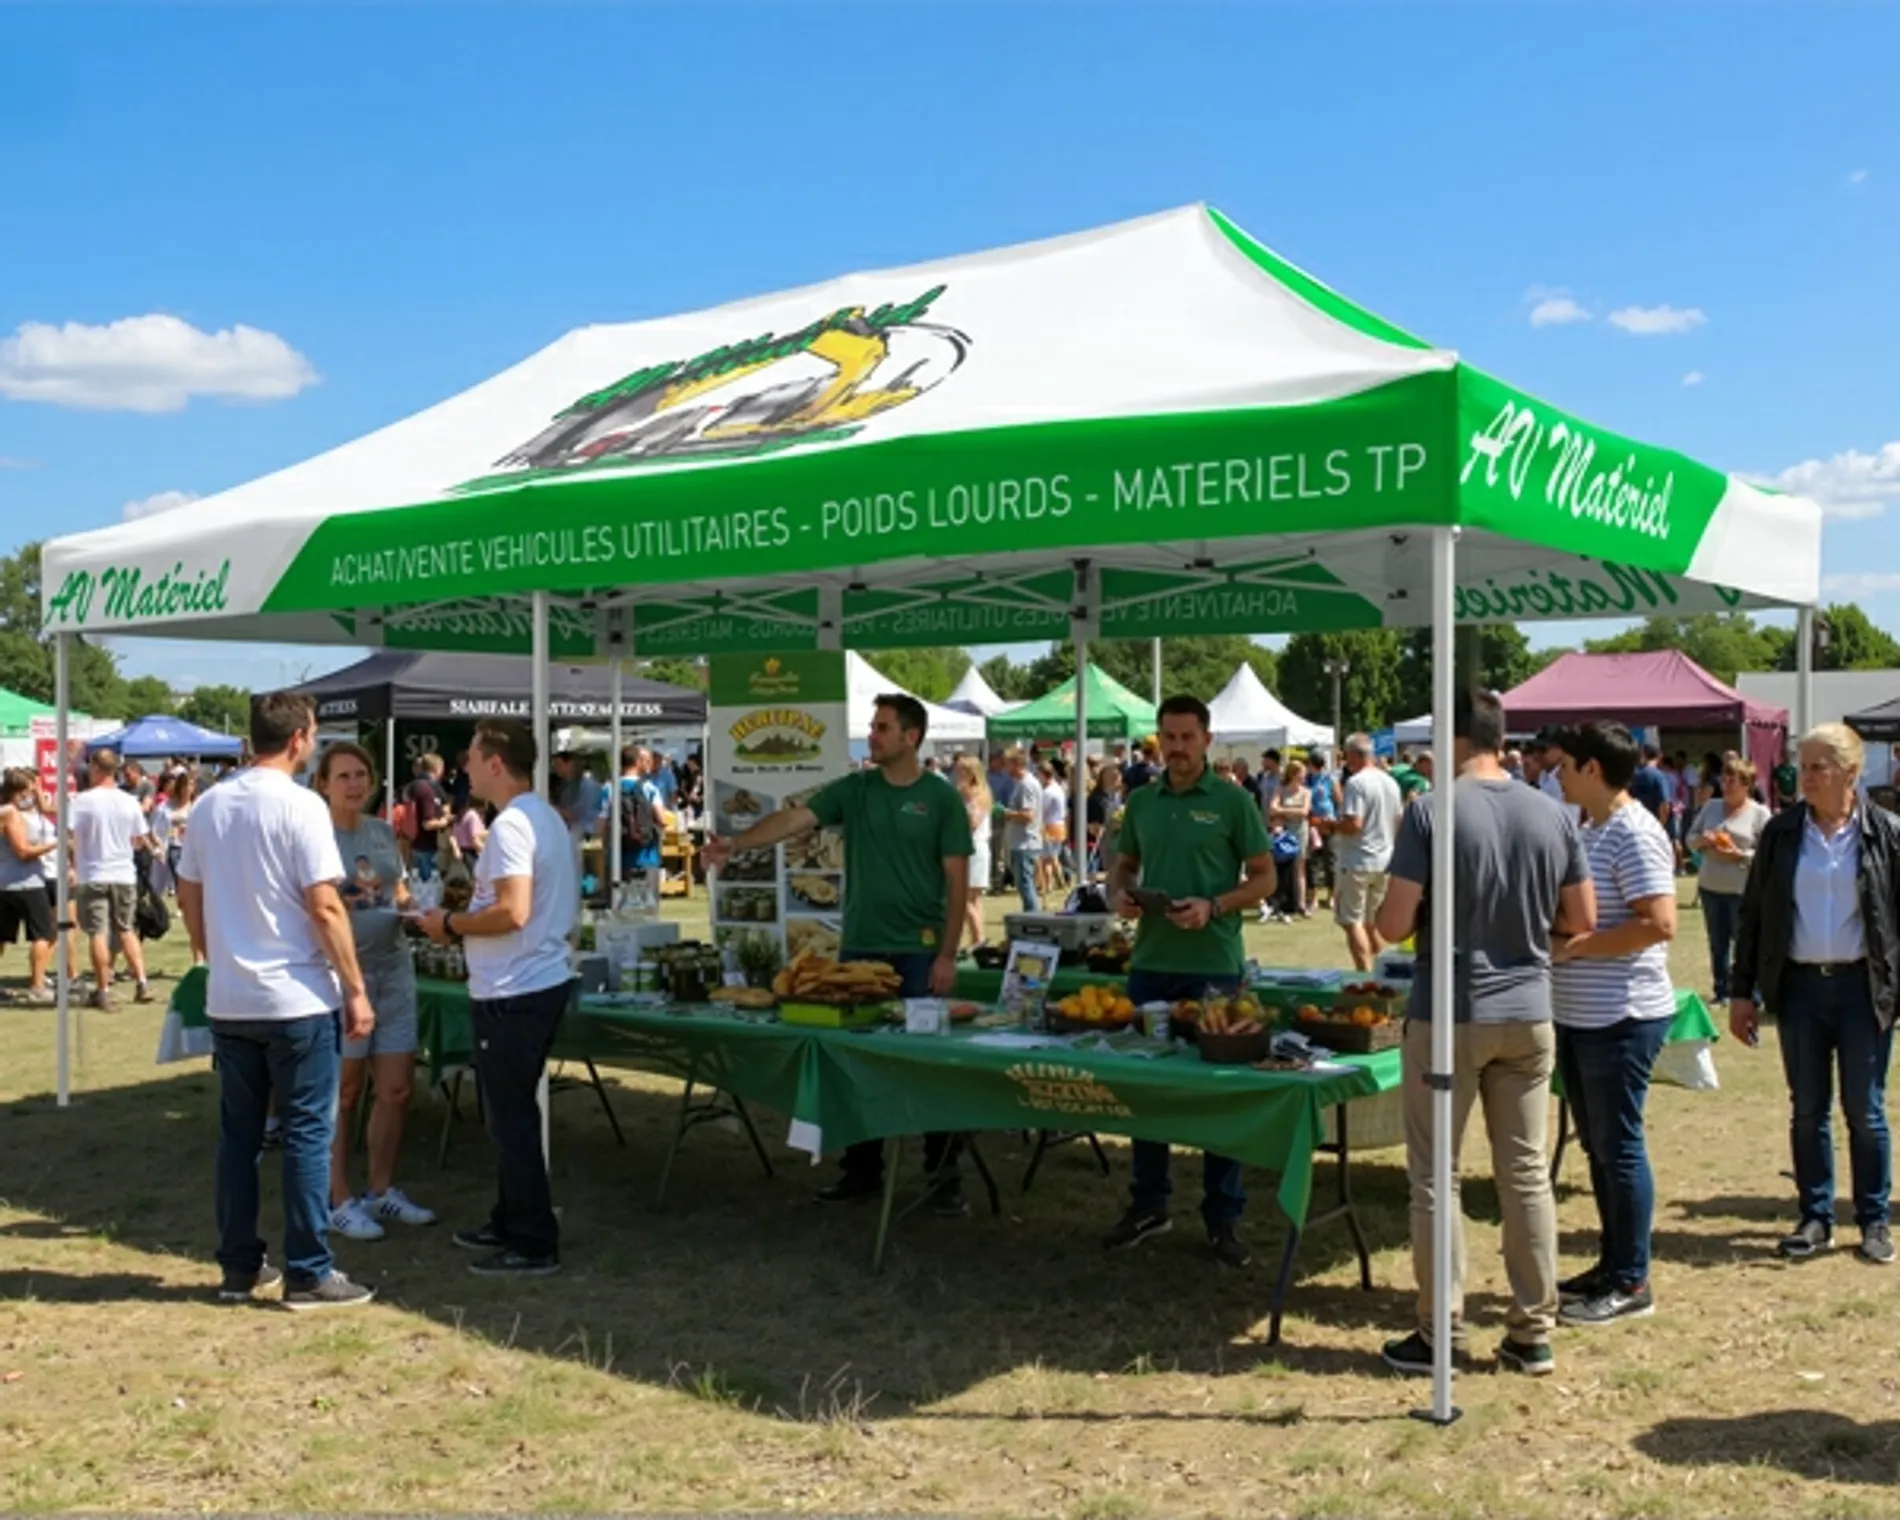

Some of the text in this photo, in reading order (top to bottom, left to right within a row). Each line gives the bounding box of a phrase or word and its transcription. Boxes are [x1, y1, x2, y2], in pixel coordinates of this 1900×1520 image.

[330, 540, 474, 586] ACHAT/VENTE
[479, 525, 616, 571] VEHICULES
[621, 507, 790, 558] UTILITAIRES
[821, 490, 918, 540] POIDS
[928, 474, 1073, 527] LOURDS
[1113, 449, 1351, 512] MATERIELS
[1366, 443, 1427, 492] TP
[1460, 399, 1674, 540] AV Matériel
[45, 556, 231, 625] AV Matériel
